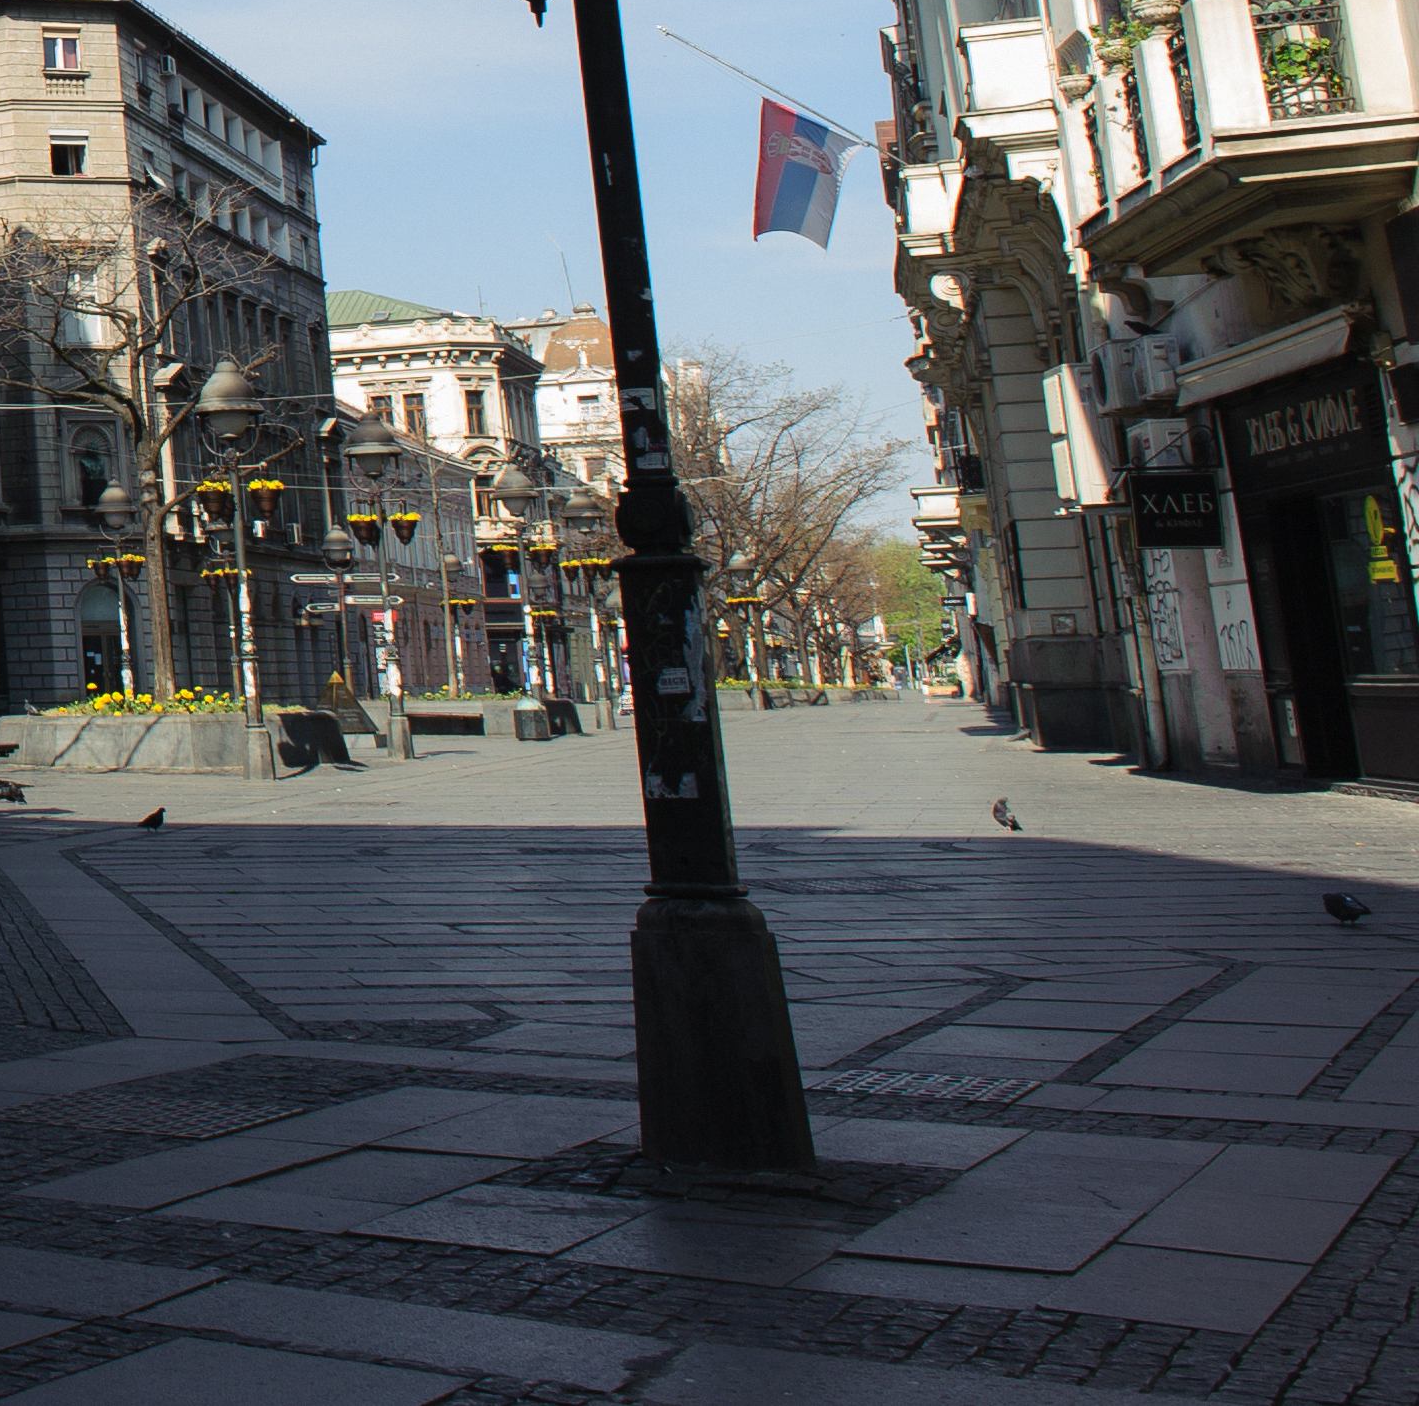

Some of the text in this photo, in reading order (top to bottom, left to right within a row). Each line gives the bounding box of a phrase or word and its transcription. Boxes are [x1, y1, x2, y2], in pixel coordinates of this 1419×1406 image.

[1246, 410, 1286, 456] ХЛЕБ
[1286, 406, 1301, 446] &
[1300, 388, 1363, 442] КИФЛЕ
[1142, 493, 1213, 513] ХЛЕБ
